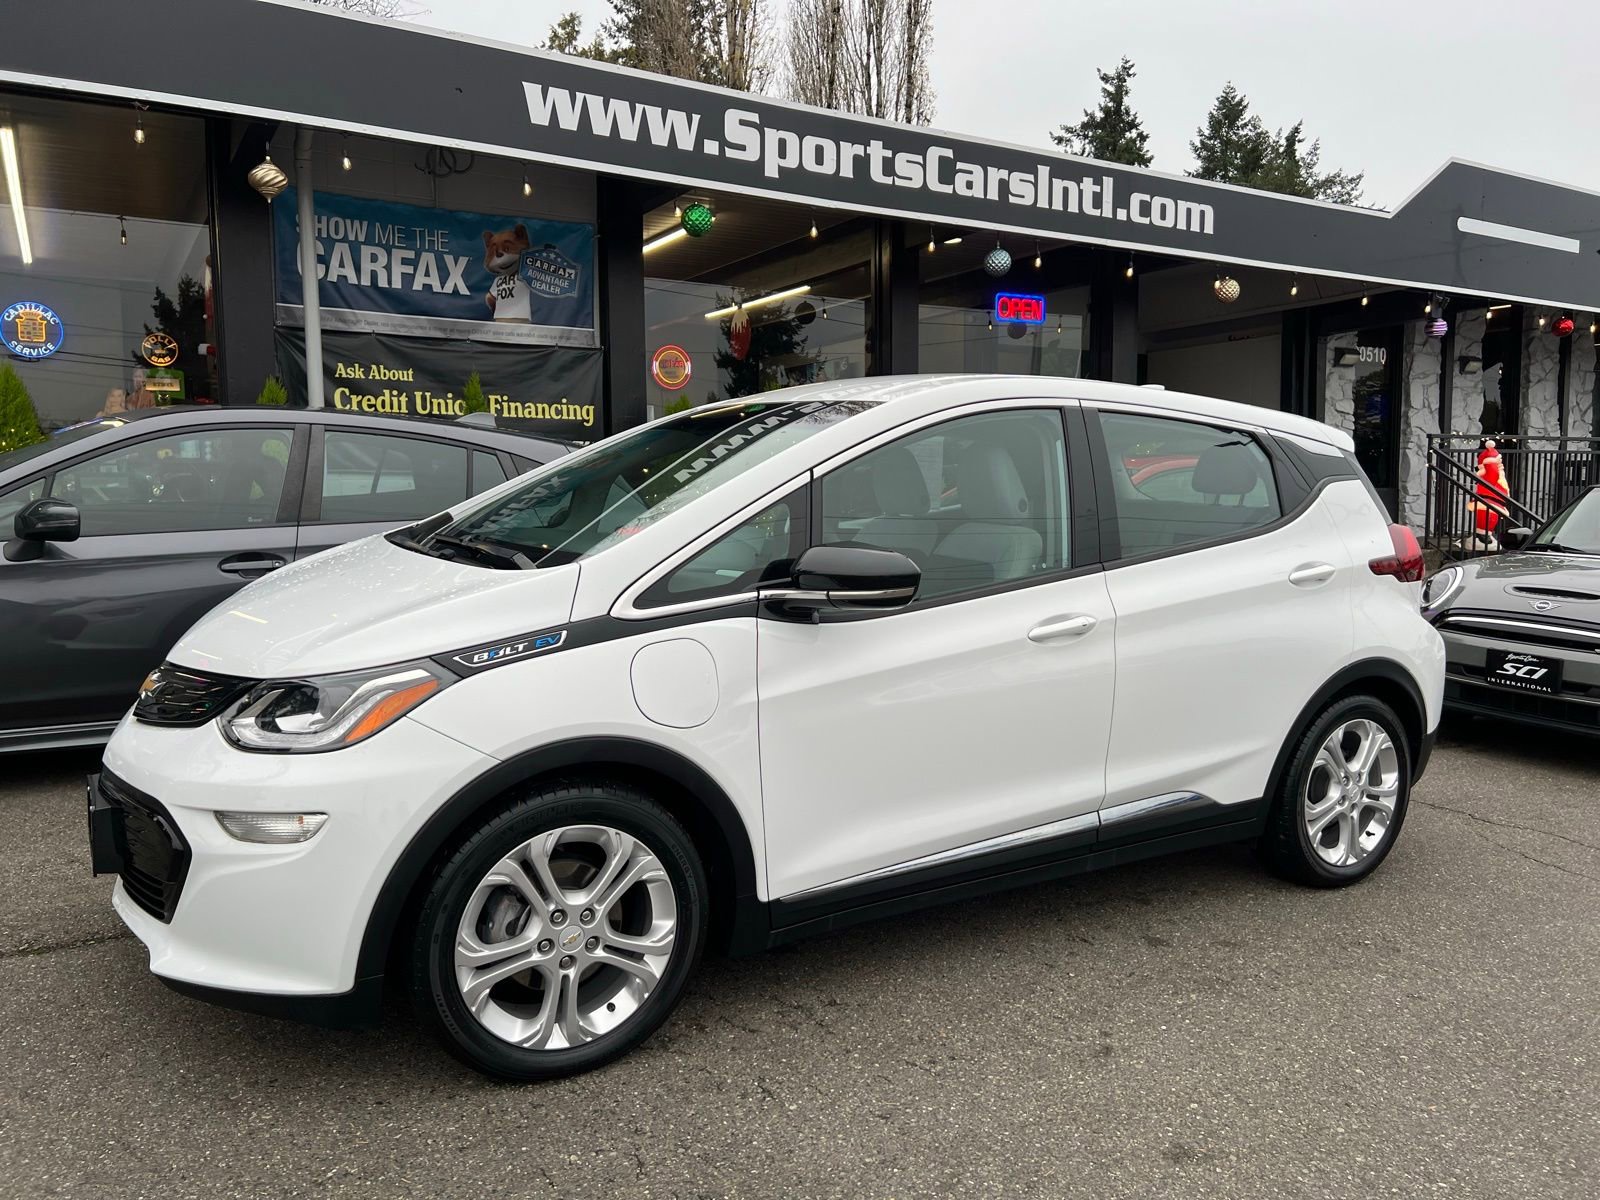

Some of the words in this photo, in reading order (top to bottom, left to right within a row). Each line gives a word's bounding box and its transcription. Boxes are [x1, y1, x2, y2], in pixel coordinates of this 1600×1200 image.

[521, 80, 1215, 235] www.SportsCarsIntl.com
[296, 214, 368, 242] HOW
[375, 222, 406, 247] ME
[411, 227, 449, 252] THE
[525, 257, 576, 279] CARFAX
[497, 275, 516, 288] CAR
[527, 269, 569, 288] ADVANTAGE
[531, 280, 561, 295] DEALER
[496, 286, 515, 300] FOX
[4, 303, 59, 325] CADILLAC
[998, 297, 1043, 320] OPEN
[9, 340, 55, 356] SERVICE
[151, 355, 171, 363] GAS
[335, 363, 365, 379] Ask
[369, 364, 414, 382] About
[334, 387, 409, 413] Credit
[414, 391, 466, 416] Unio
[488, 394, 594, 427] Financing
[473, 642, 529, 662] BOLT
[534, 635, 560, 649] EV
[1496, 662, 1548, 679] SCI
[1487, 677, 1551, 693] INTERNATIONAL
